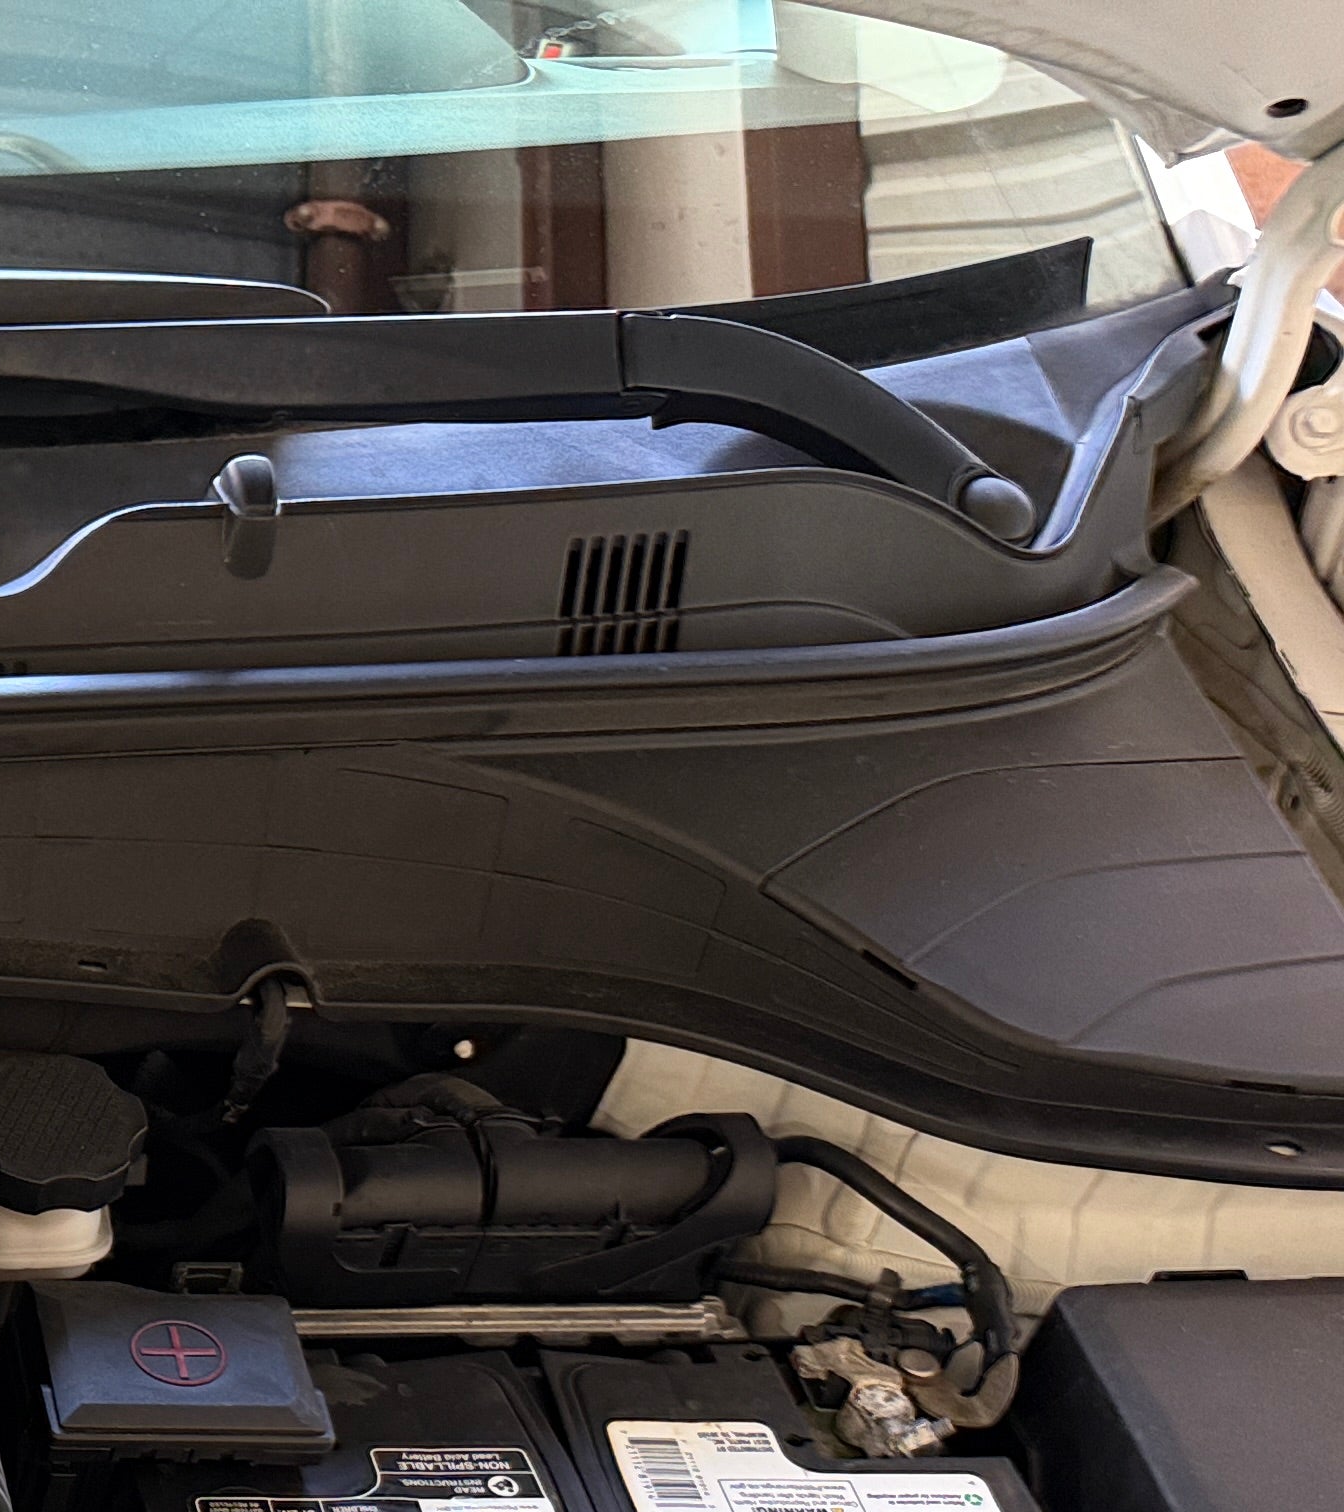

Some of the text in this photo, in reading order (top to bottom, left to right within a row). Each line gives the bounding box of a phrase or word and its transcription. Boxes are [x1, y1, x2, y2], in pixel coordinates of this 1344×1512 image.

[401, 1452, 500, 1461] Lead Acid Battery
[397, 1461, 510, 1471] NON-SPILLABLE
[454, 1486, 485, 1494] READ
